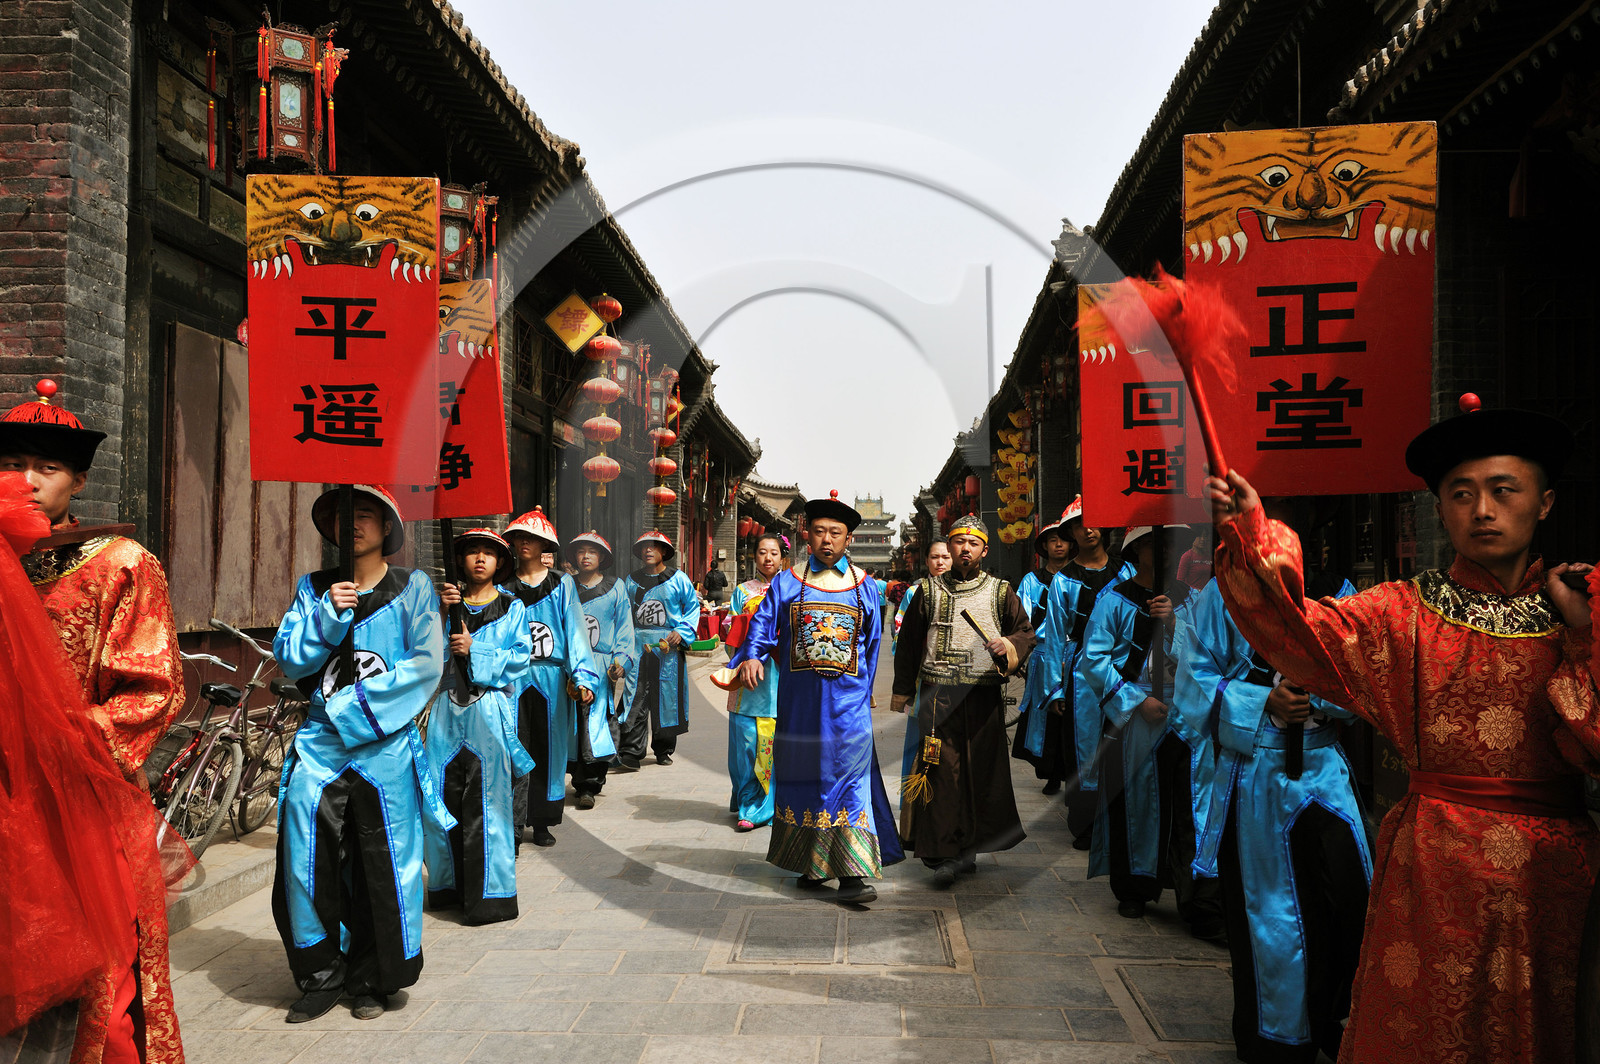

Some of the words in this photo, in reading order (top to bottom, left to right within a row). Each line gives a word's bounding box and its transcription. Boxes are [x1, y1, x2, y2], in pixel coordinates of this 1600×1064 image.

[293, 296, 386, 447] 平遥
[1250, 281, 1367, 450] 正堂
[638, 602, 665, 626] 衙
